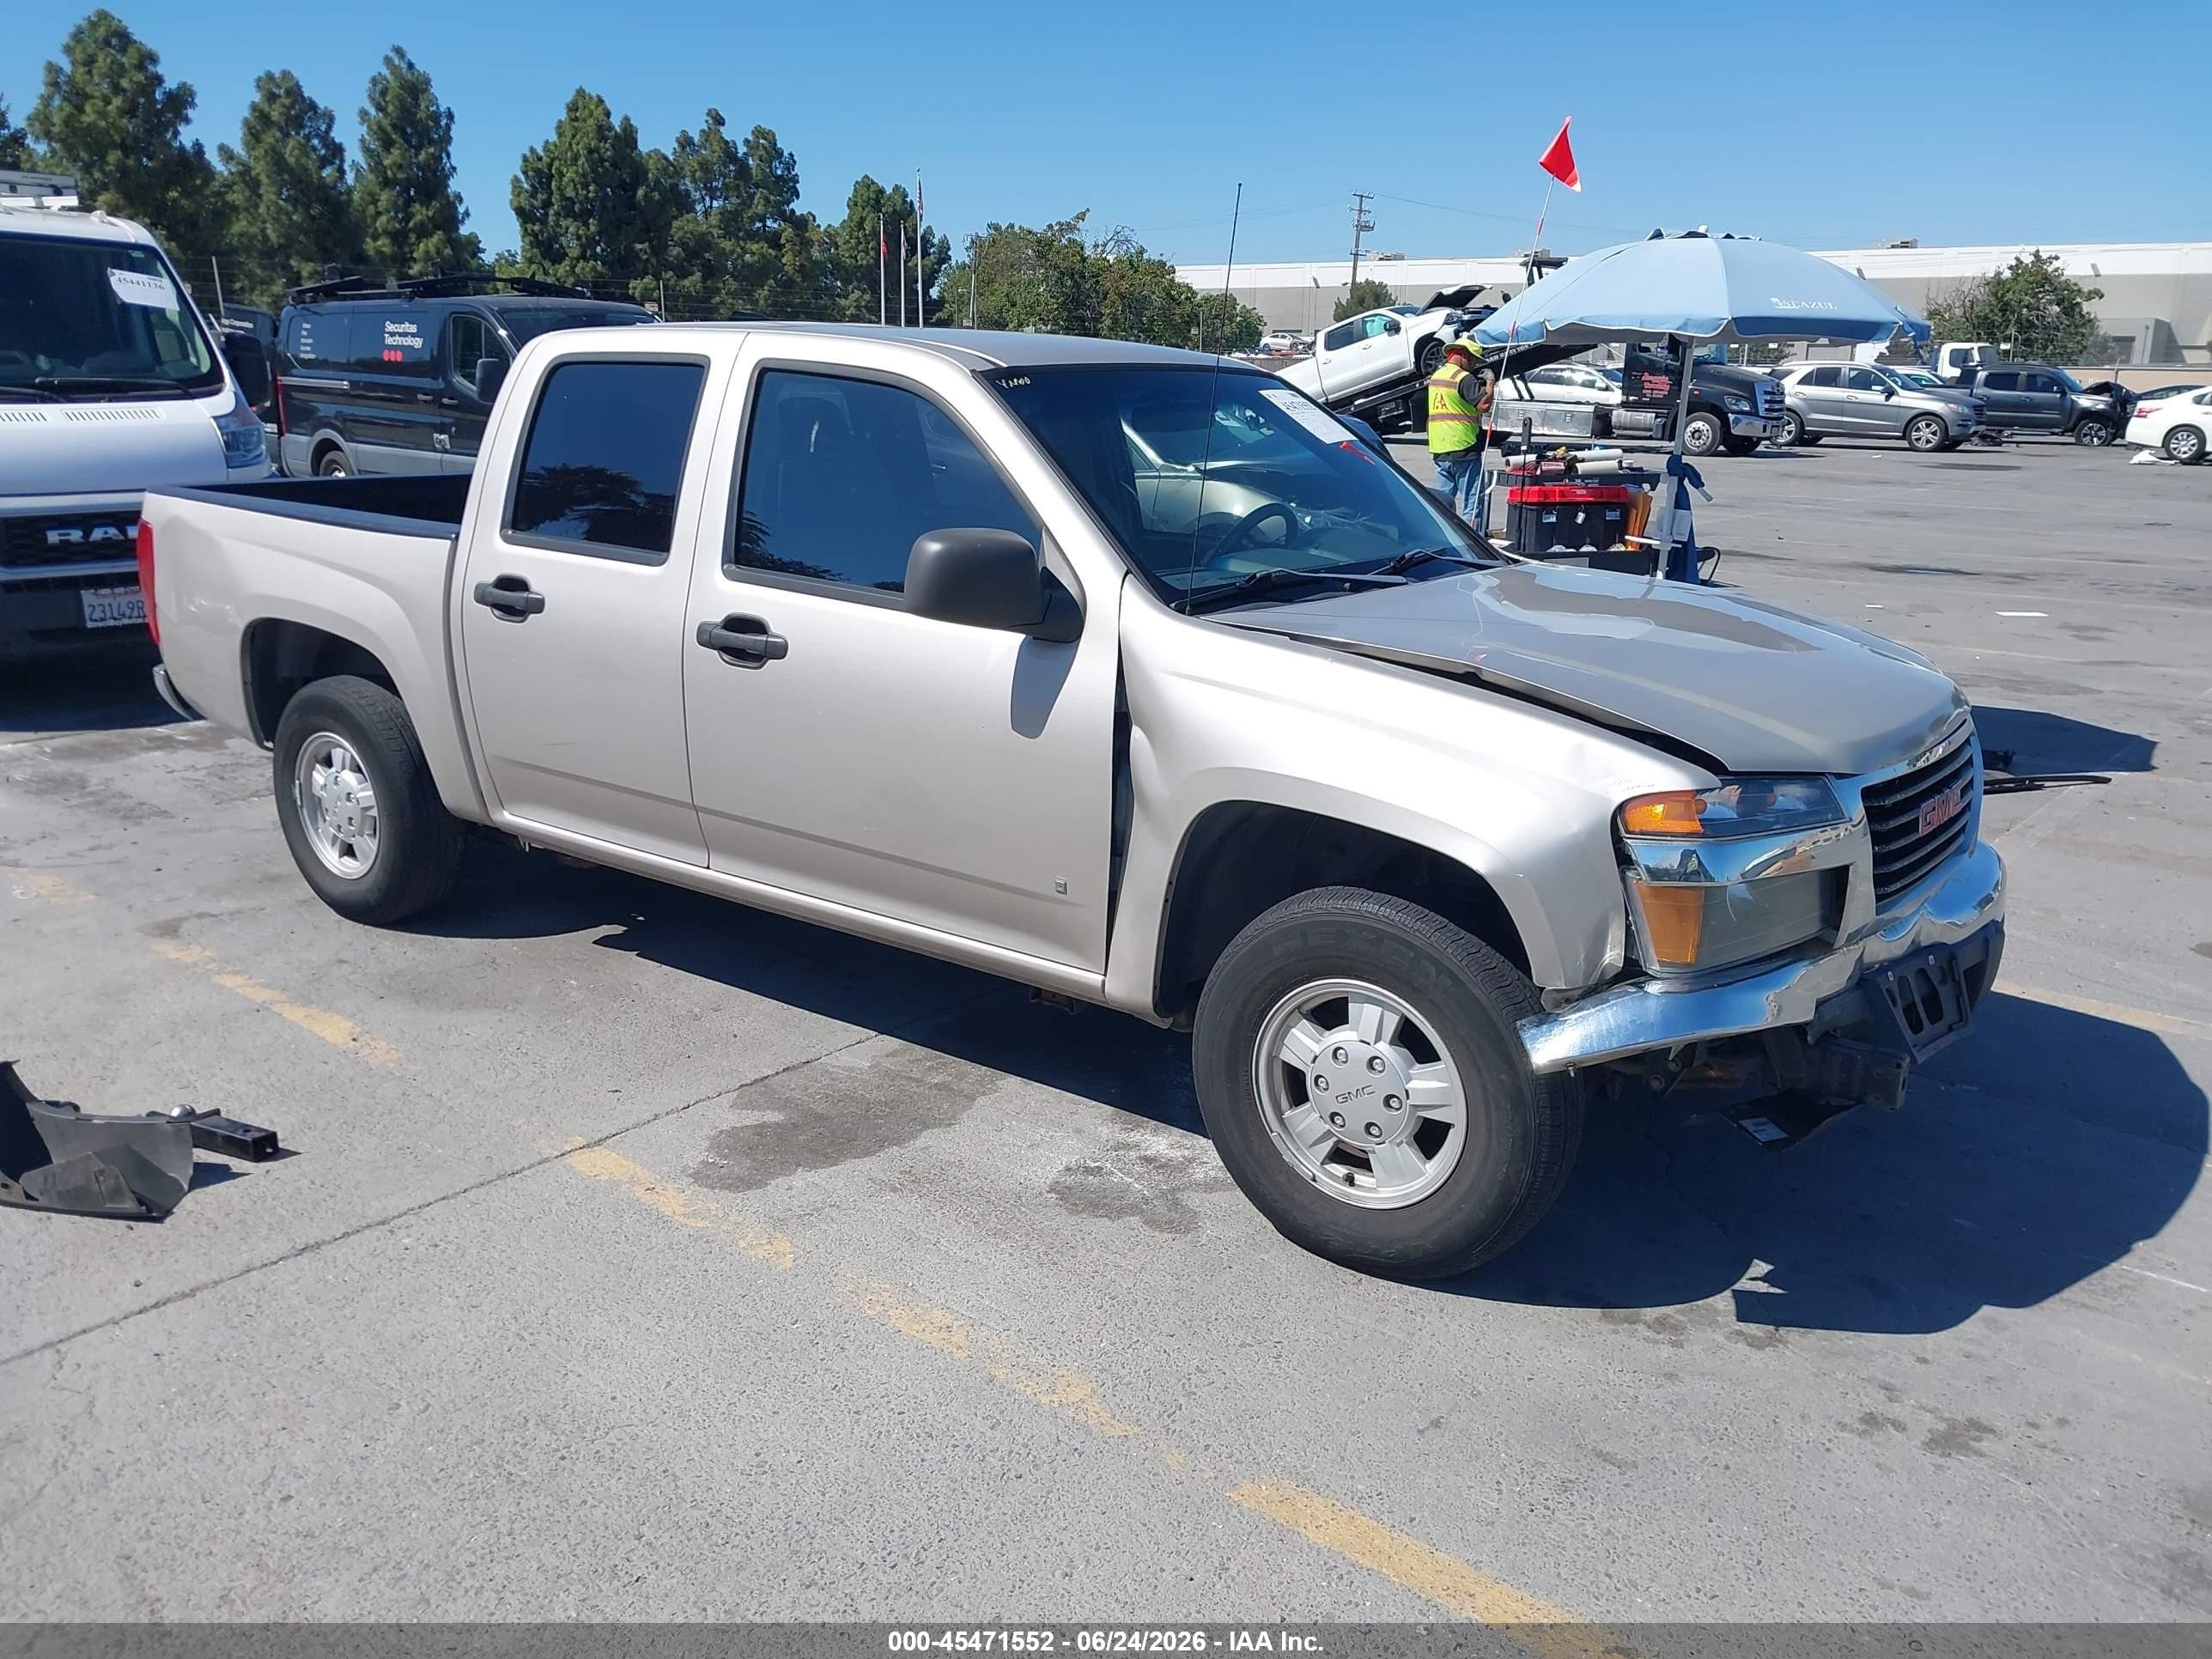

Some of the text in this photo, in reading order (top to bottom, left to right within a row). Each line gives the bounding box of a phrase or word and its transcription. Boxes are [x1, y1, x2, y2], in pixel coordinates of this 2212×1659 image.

[385, 320, 418, 333] Securitas
[384, 333, 423, 349] Technology
[1918, 780, 1963, 838] GMC
[1334, 1084, 1376, 1105] GMC
